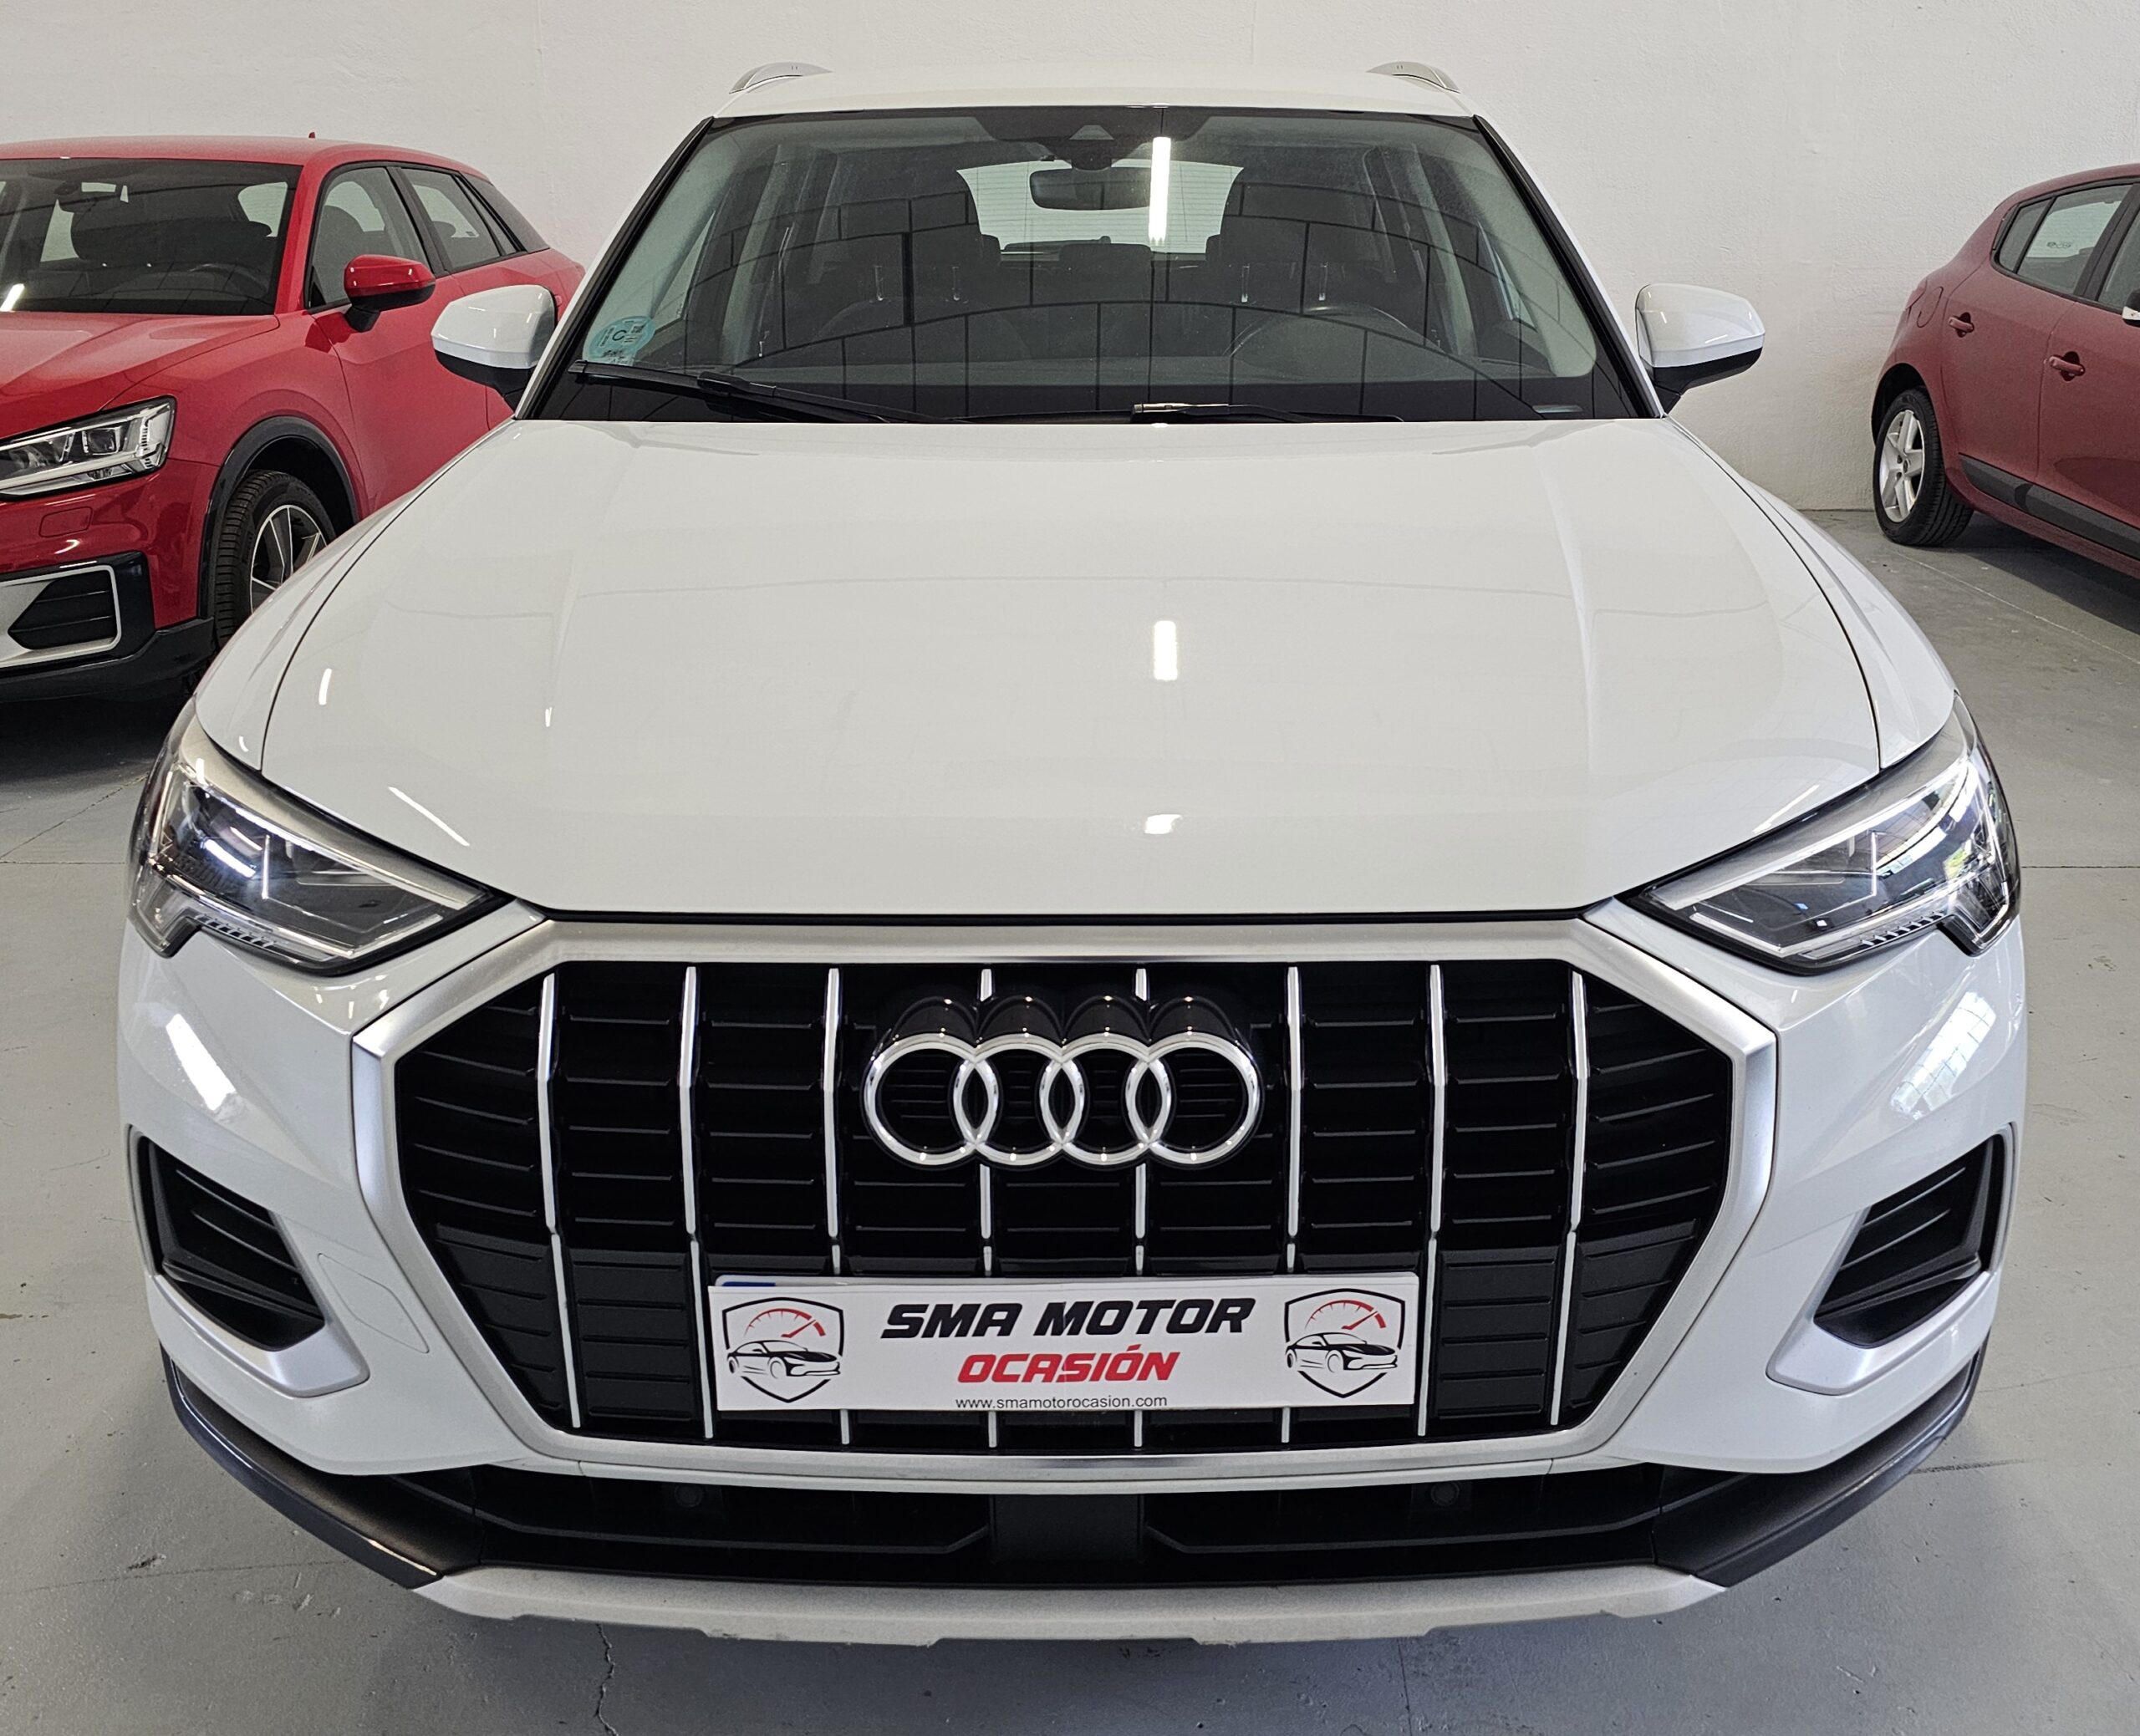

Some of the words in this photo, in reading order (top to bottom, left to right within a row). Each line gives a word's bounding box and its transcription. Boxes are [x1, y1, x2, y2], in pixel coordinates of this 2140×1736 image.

[612, 329, 627, 341] C
[880, 1302, 1023, 1339] SMA
[1032, 1298, 1256, 1336] MOTOR
[957, 1344, 1180, 1382] OCASIÓN
[955, 1395, 1168, 1409] www.smamotorocasion.com
